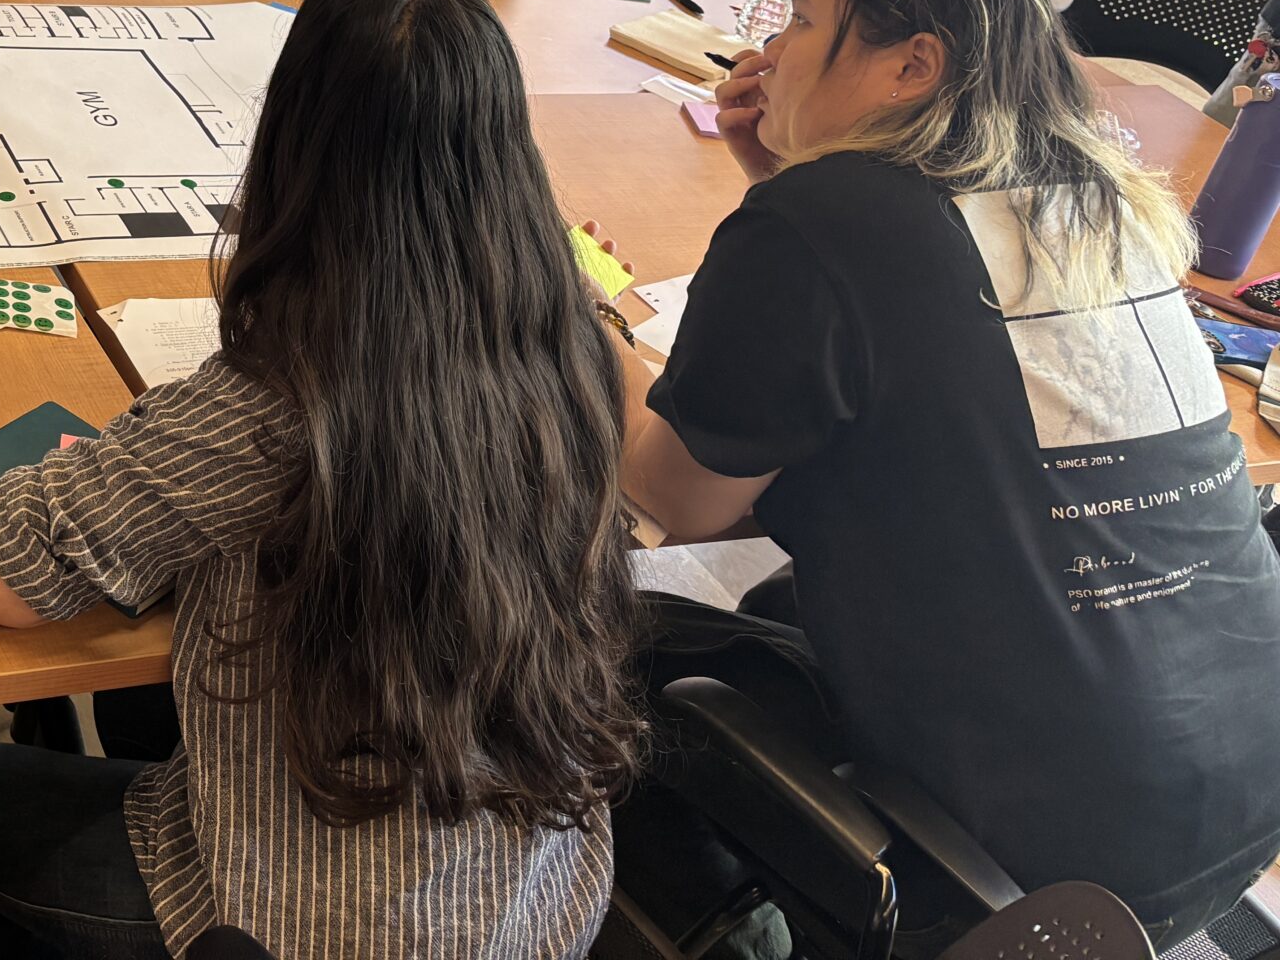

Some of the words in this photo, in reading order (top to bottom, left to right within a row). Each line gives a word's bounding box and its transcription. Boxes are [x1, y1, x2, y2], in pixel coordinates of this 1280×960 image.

[76, 91, 118, 127] GYM
[187, 206, 201, 218] STAIR
[64, 220, 79, 236] STAIR
[1055, 459, 1089, 470] SINCE
[1091, 455, 1114, 467] 2015
[1051, 506, 1079, 520] NO
[1083, 498, 1136, 518] MORE
[1190, 477, 1216, 497] FOR
[1215, 468, 1233, 486] THE
[1094, 585, 1118, 598] brand
[1118, 583, 1126, 592] is
[1127, 583, 1133, 591] a
[1134, 576, 1164, 589] master
[1136, 590, 1152, 603] and
